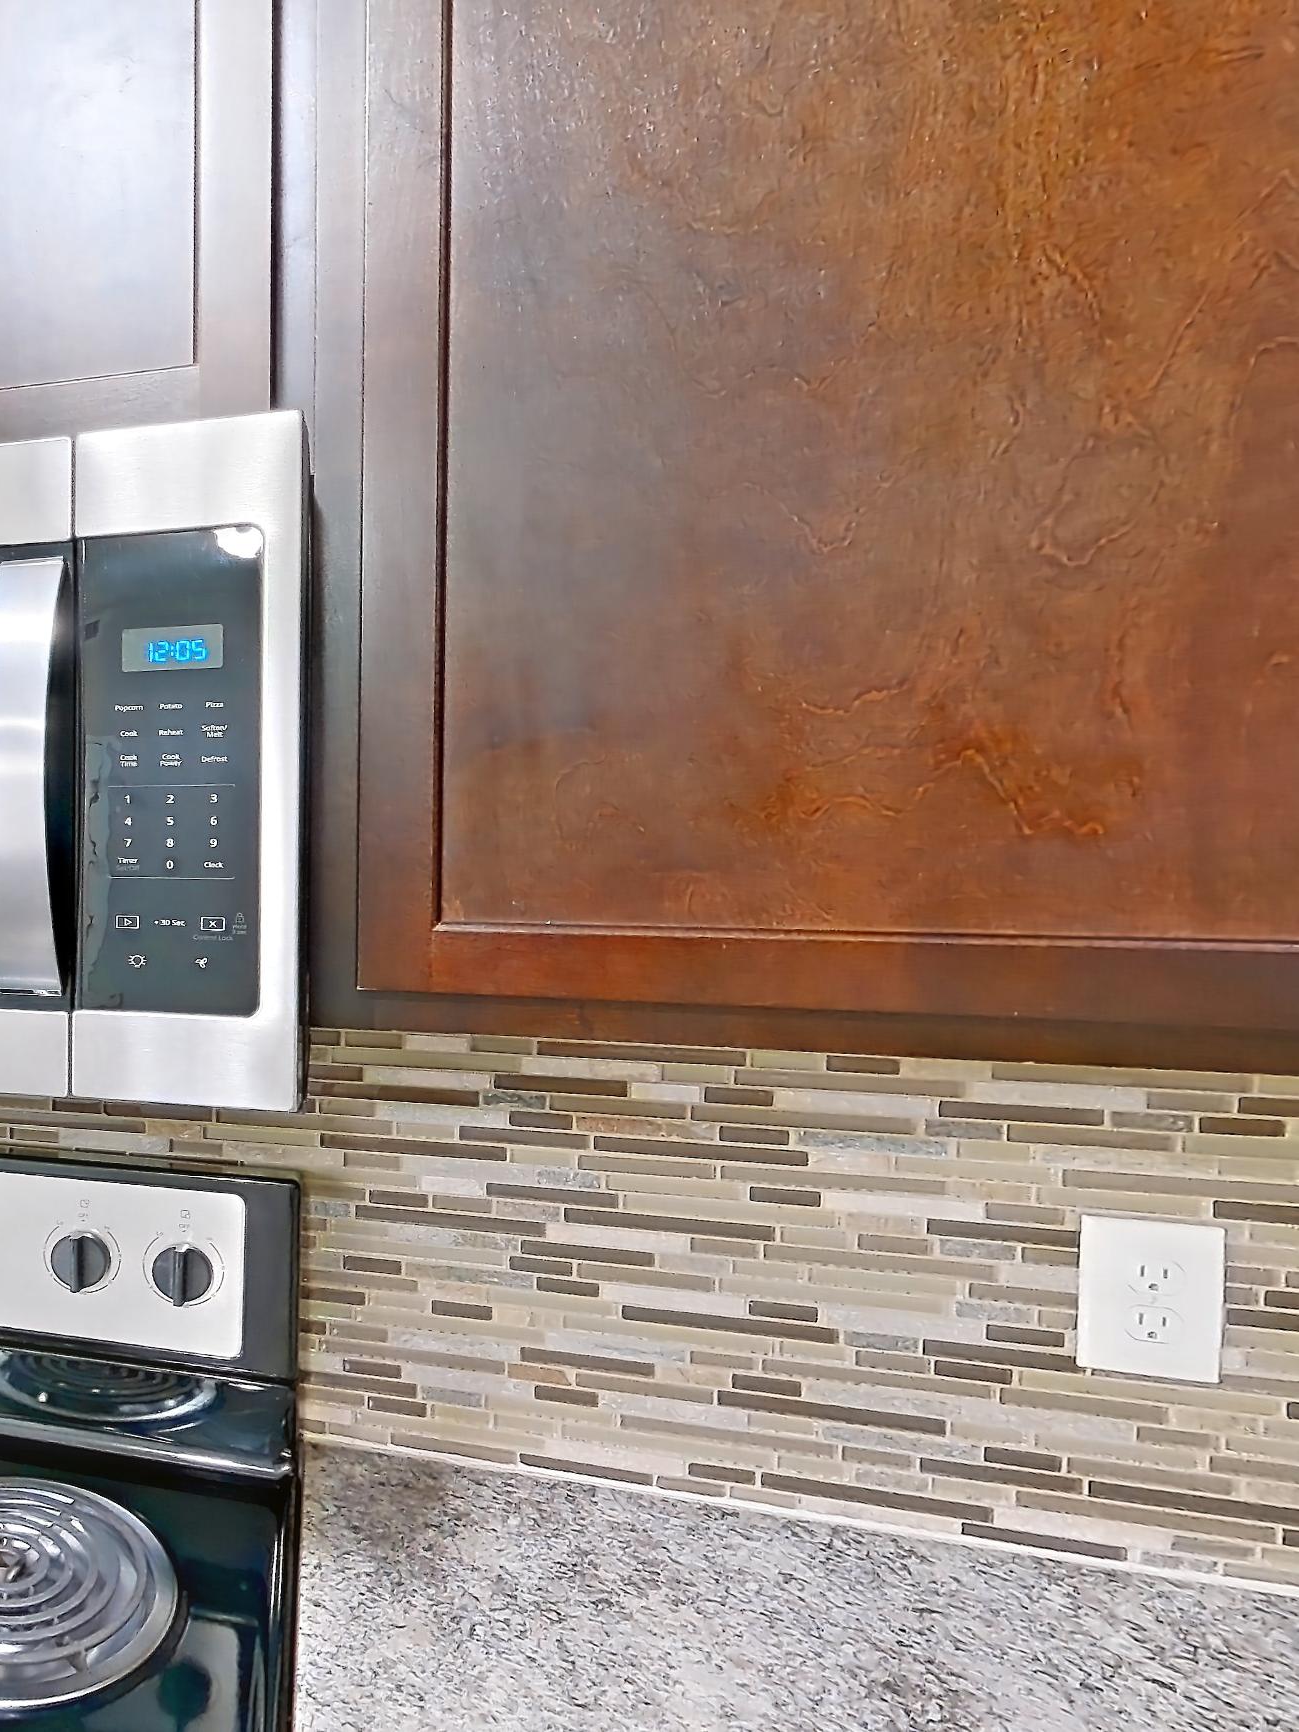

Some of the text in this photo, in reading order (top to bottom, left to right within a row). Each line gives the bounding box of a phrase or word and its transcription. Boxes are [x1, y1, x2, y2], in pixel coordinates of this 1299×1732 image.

[148, 638, 208, 663] 12:05
[114, 704, 144, 713] Popcorn
[159, 702, 183, 710] Potato
[201, 755, 228, 763] Defrost
[124, 794, 131, 804] 1
[165, 794, 175, 804] 2
[209, 793, 218, 803] 3
[124, 816, 132, 826] 4
[166, 816, 174, 826] 5
[210, 816, 218, 825] 6
[124, 838, 132, 847] 7
[165, 838, 174, 848] 8
[209, 838, 217, 848] 9
[166, 860, 174, 870] 0
[204, 861, 224, 869] Clock
